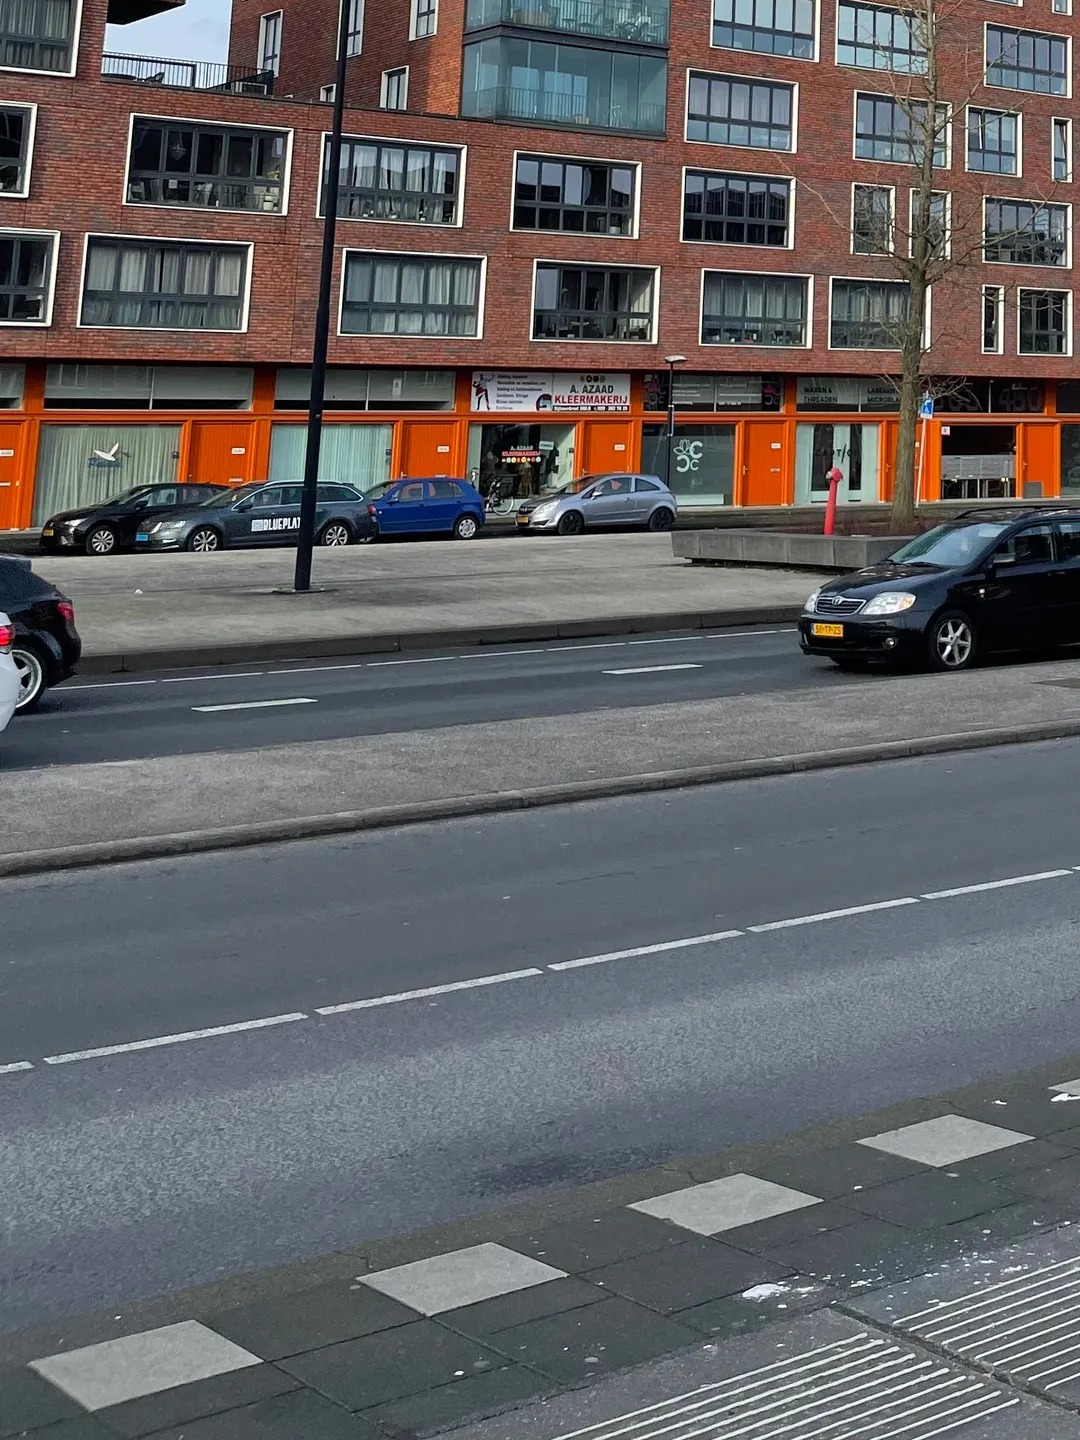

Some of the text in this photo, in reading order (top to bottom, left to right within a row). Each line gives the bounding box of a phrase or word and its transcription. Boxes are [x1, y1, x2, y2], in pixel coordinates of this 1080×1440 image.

[570, 384, 614, 394] A. AZAAD
[554, 395, 629, 404] KLEERMAKERIJ
